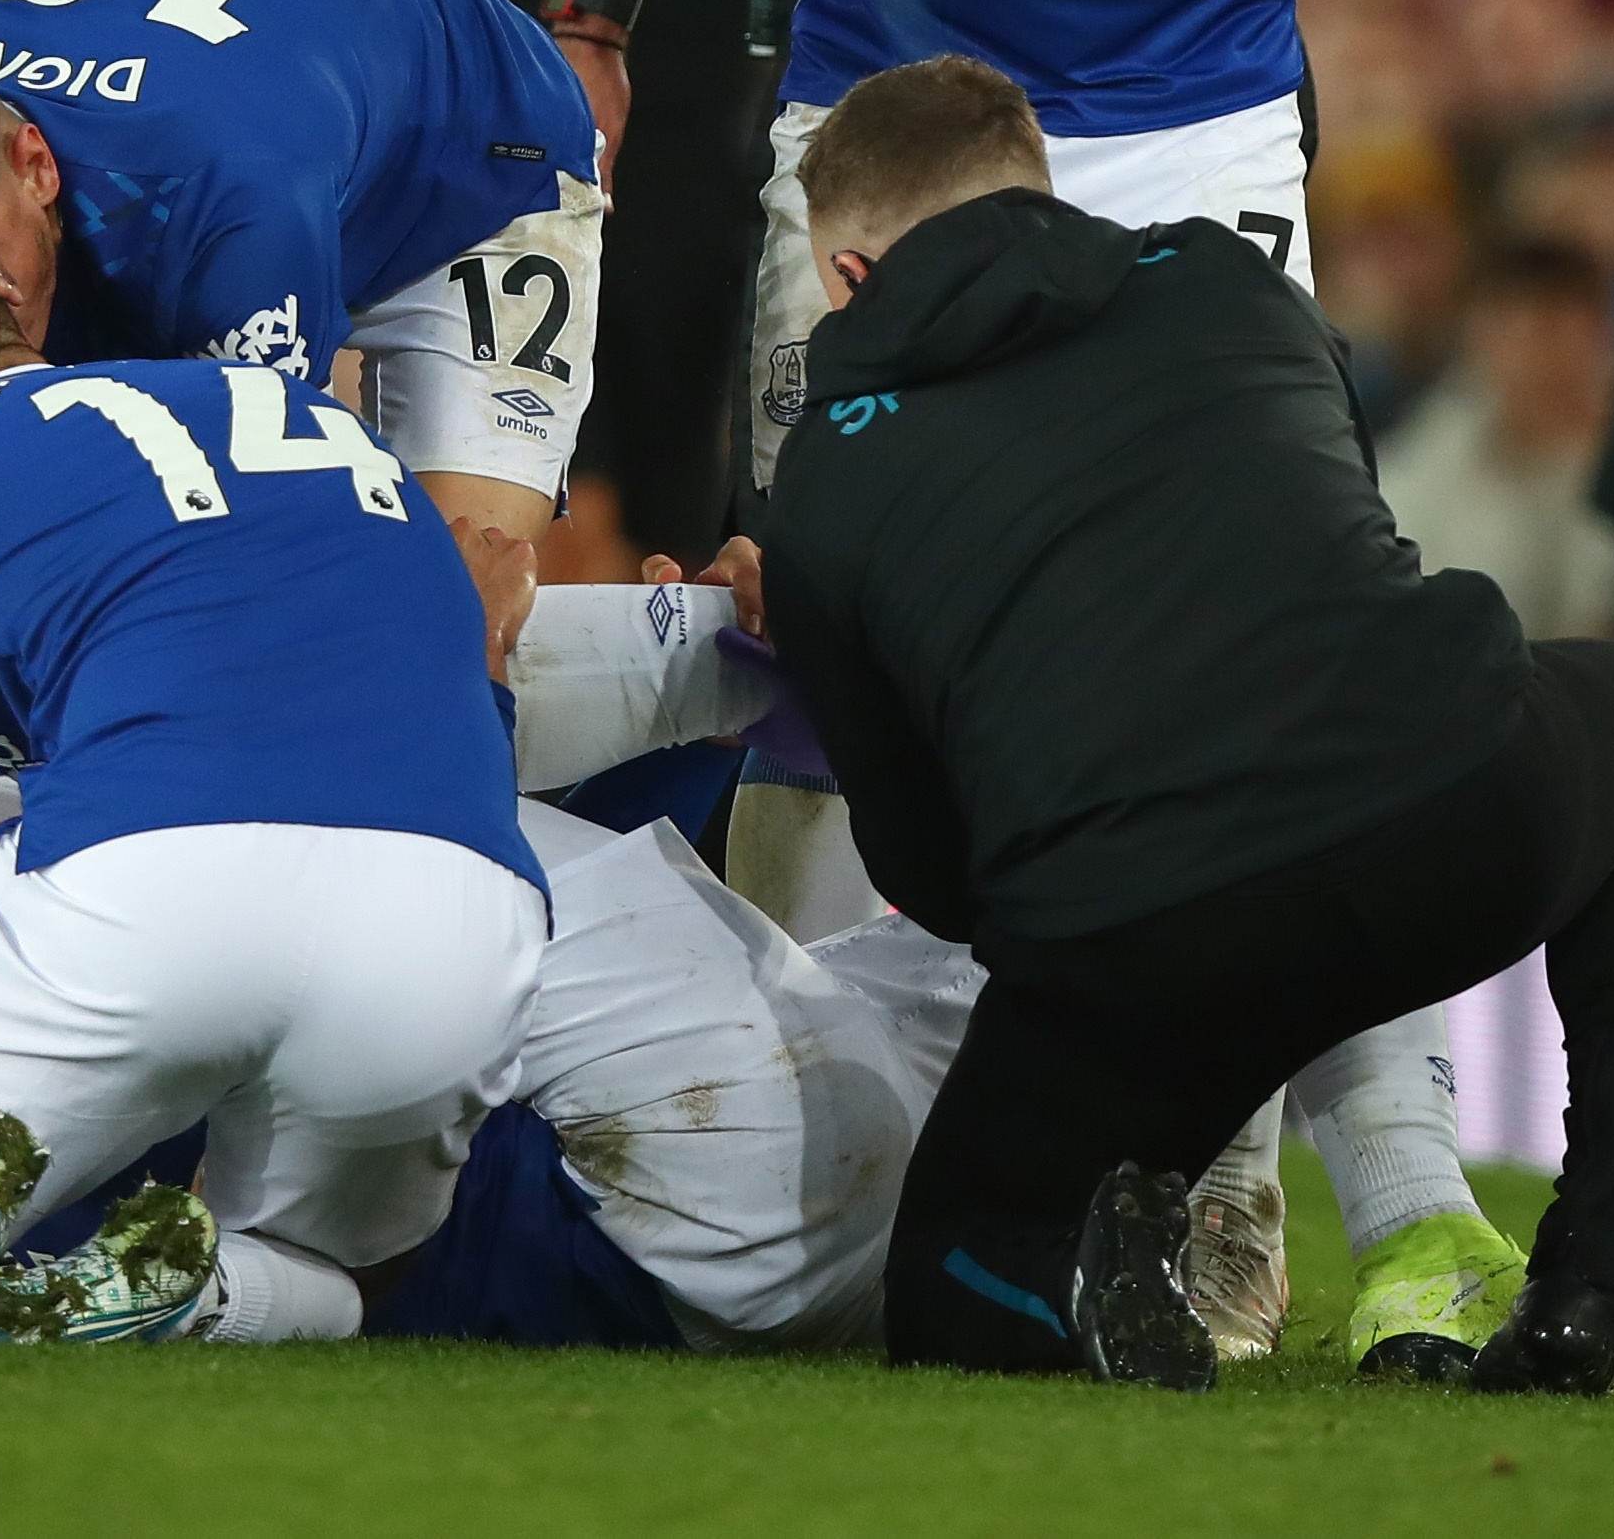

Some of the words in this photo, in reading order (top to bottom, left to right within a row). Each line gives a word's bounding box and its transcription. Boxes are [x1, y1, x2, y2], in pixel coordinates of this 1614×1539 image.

[447, 253, 572, 385] 12
[29, 366, 409, 523] 14
[496, 414, 548, 440] umbro
